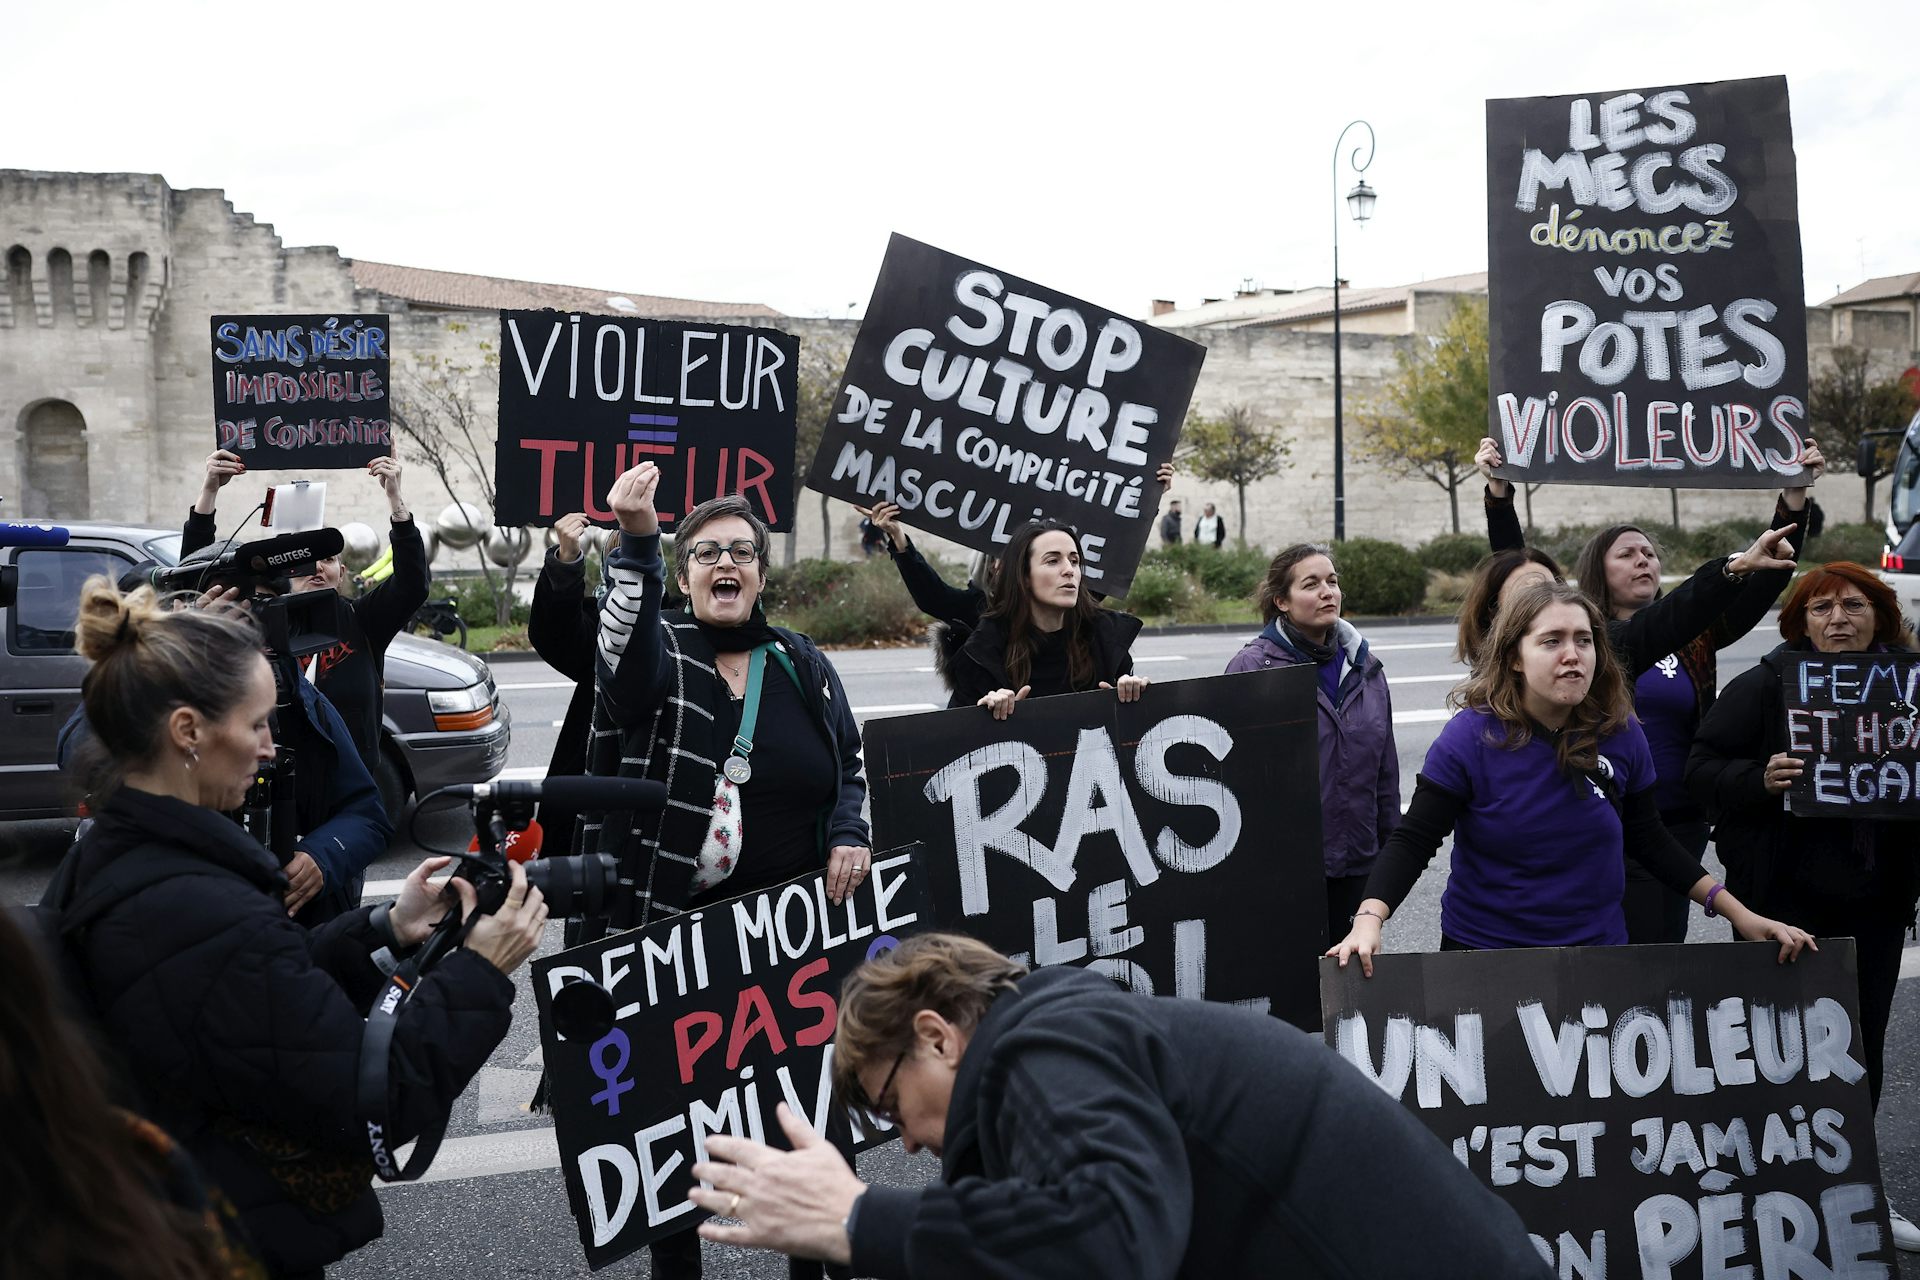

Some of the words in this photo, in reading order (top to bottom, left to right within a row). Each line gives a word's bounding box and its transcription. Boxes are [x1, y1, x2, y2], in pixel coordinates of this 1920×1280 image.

[1569, 90, 1696, 152] LES
[1516, 143, 1737, 214] MECS
[1530, 203, 1735, 254] dénoncez
[215, 322, 308, 367] SANS
[946, 270, 1142, 388] STOP
[1541, 299, 1786, 391] POTES
[837, 384, 893, 434] DE
[901, 408, 943, 454] LA
[884, 328, 1158, 466] CULTURE
[218, 417, 257, 450] DE
[831, 441, 1106, 580] MASCULE
[267, 547, 312, 566] REUTERS
[1787, 709, 1840, 753] ET
[1856, 711, 1920, 755] HO
[1814, 754, 1920, 804] ÉGA
[923, 714, 1242, 917] RAS
[732, 854, 917, 975] MOLLE
[1033, 879, 1144, 967] LE
[673, 957, 837, 1084] PAS
[1335, 1007, 1487, 1108] UN
[1453, 1121, 1606, 1187] 'EST
